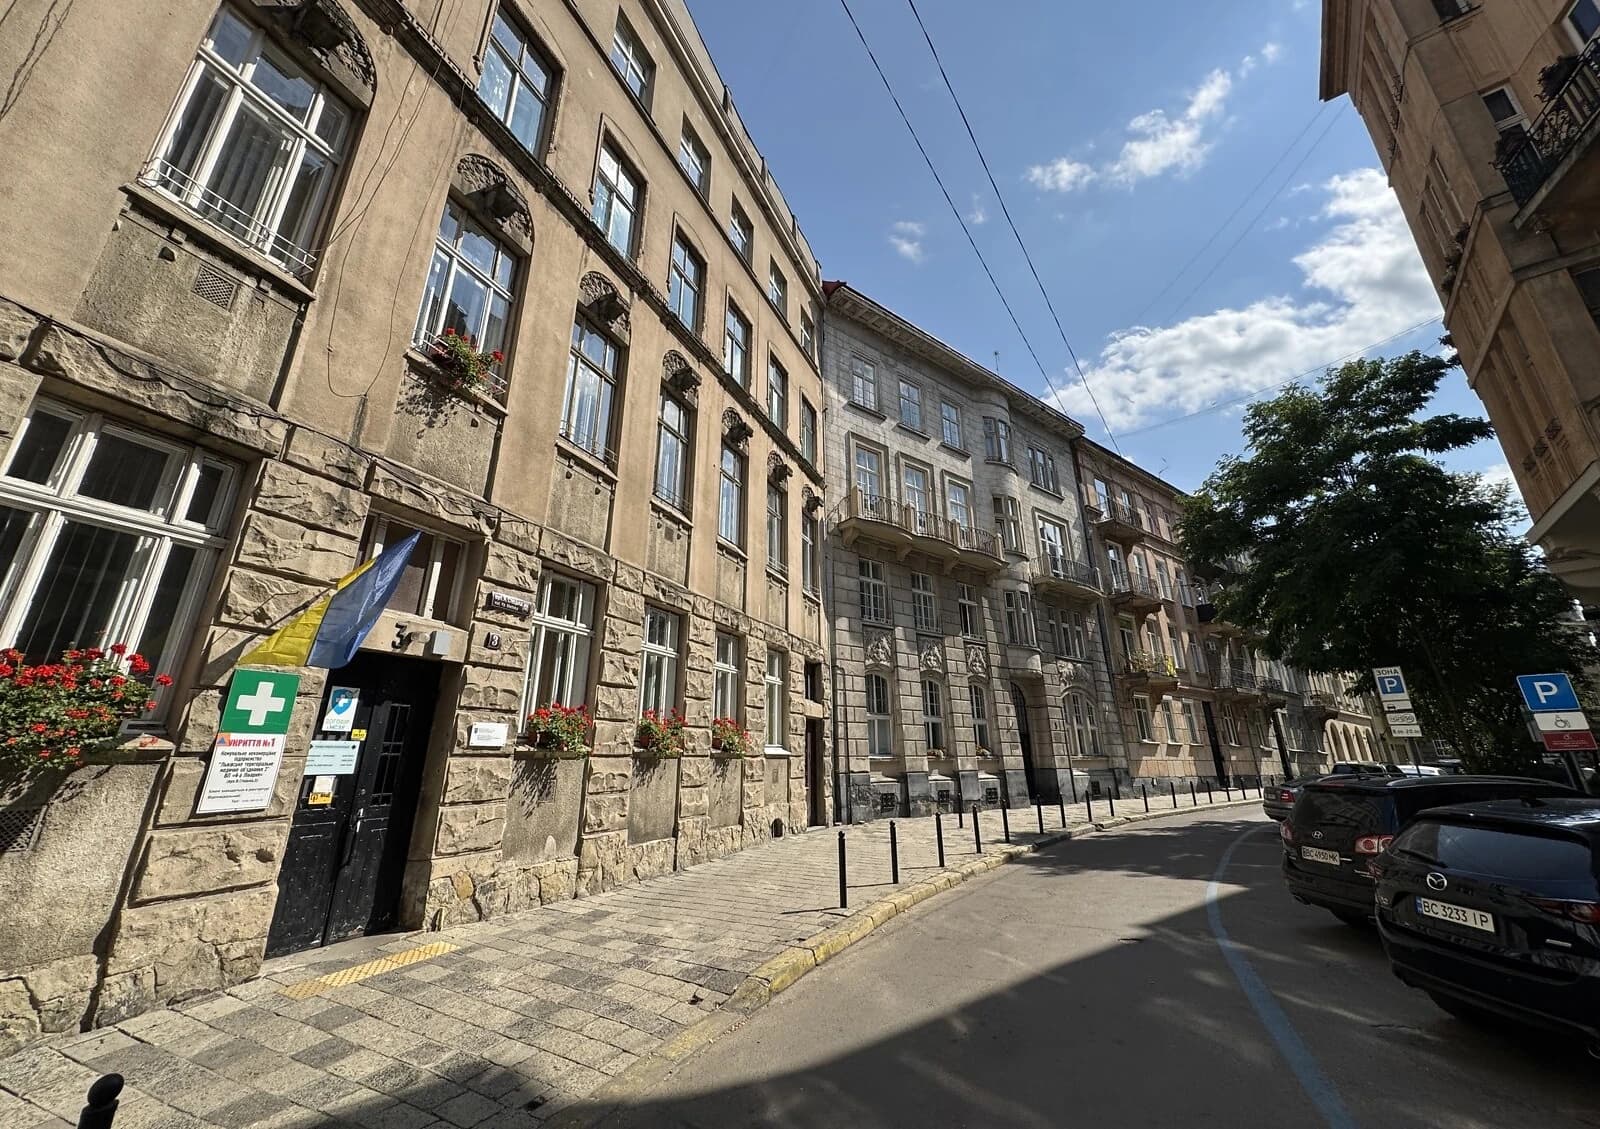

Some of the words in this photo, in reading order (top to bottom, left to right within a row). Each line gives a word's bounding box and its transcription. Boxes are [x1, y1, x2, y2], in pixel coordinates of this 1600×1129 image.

[391, 622, 408, 649] 3
[491, 634, 499, 646] 3
[1376, 668, 1400, 676] ЗОНА
[1384, 678, 1397, 692] P
[1534, 681, 1558, 704] P
[229, 739, 261, 747] УКРИТТЯ
[262, 738, 276, 747] №1
[1423, 901, 1438, 915] BC
[1440, 905, 1468, 922] 3233
[1472, 912, 1489, 927] IP
